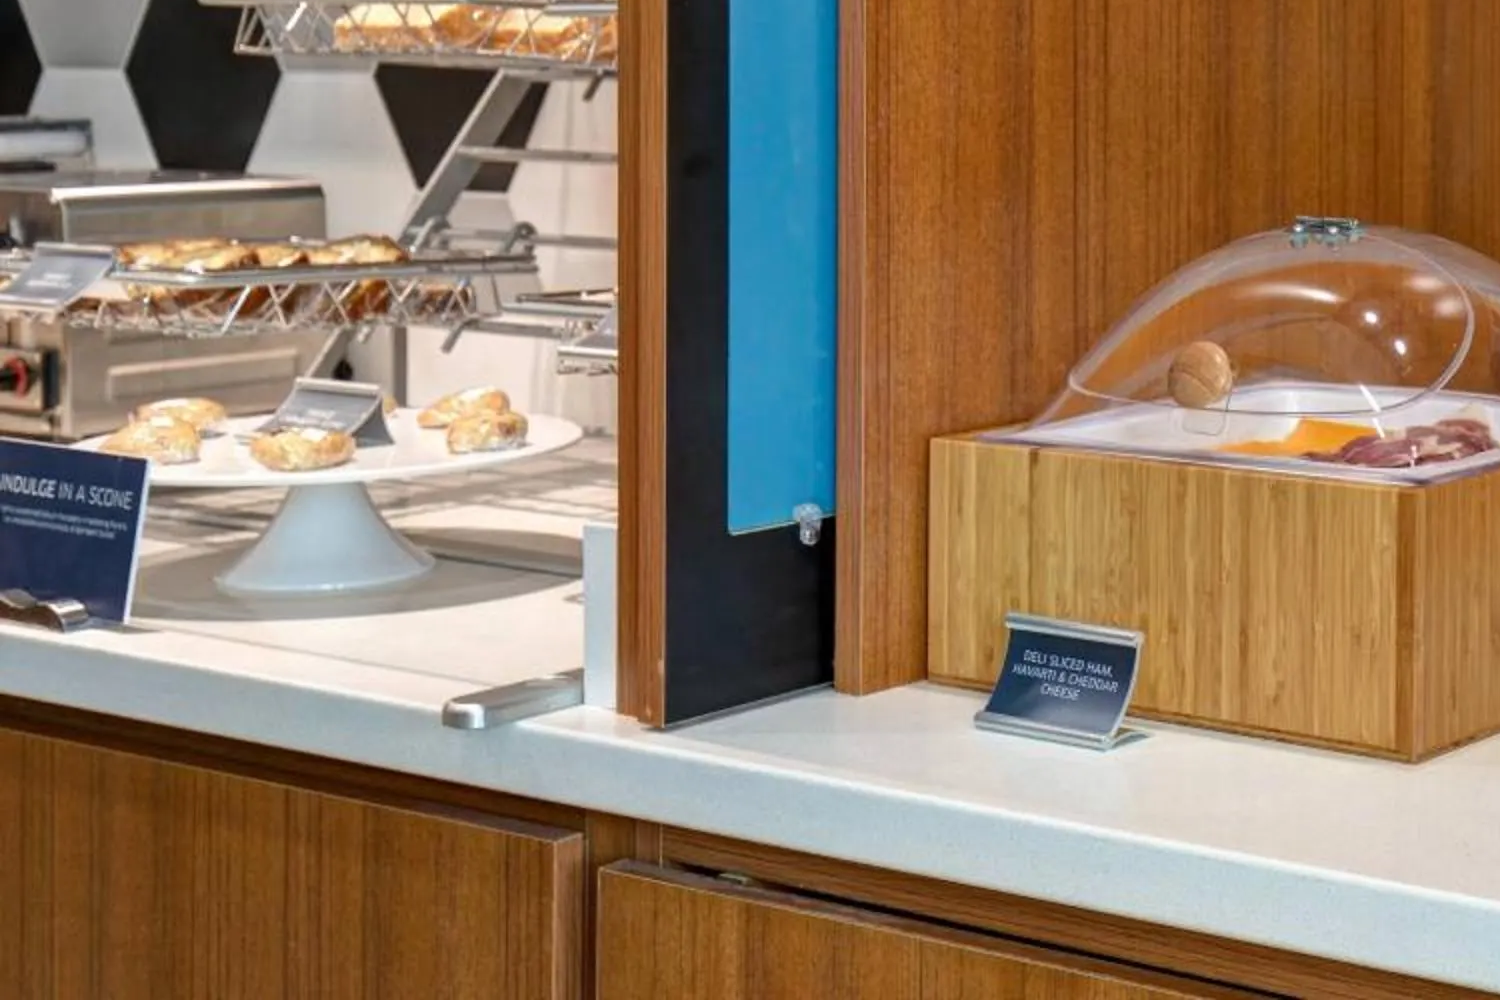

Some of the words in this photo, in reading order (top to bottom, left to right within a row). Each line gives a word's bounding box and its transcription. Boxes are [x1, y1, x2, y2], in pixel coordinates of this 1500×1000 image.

[75, 484, 86, 504] A
[88, 485, 134, 511] SCONE
[1023, 650, 1048, 664] DELI
[1050, 655, 1085, 671] SLICED
[1012, 663, 1057, 681] HAVARTI
[1058, 673, 1065, 683] &
[1067, 674, 1119, 693] CHEDDAR
[1040, 683, 1081, 701] CHEESE
